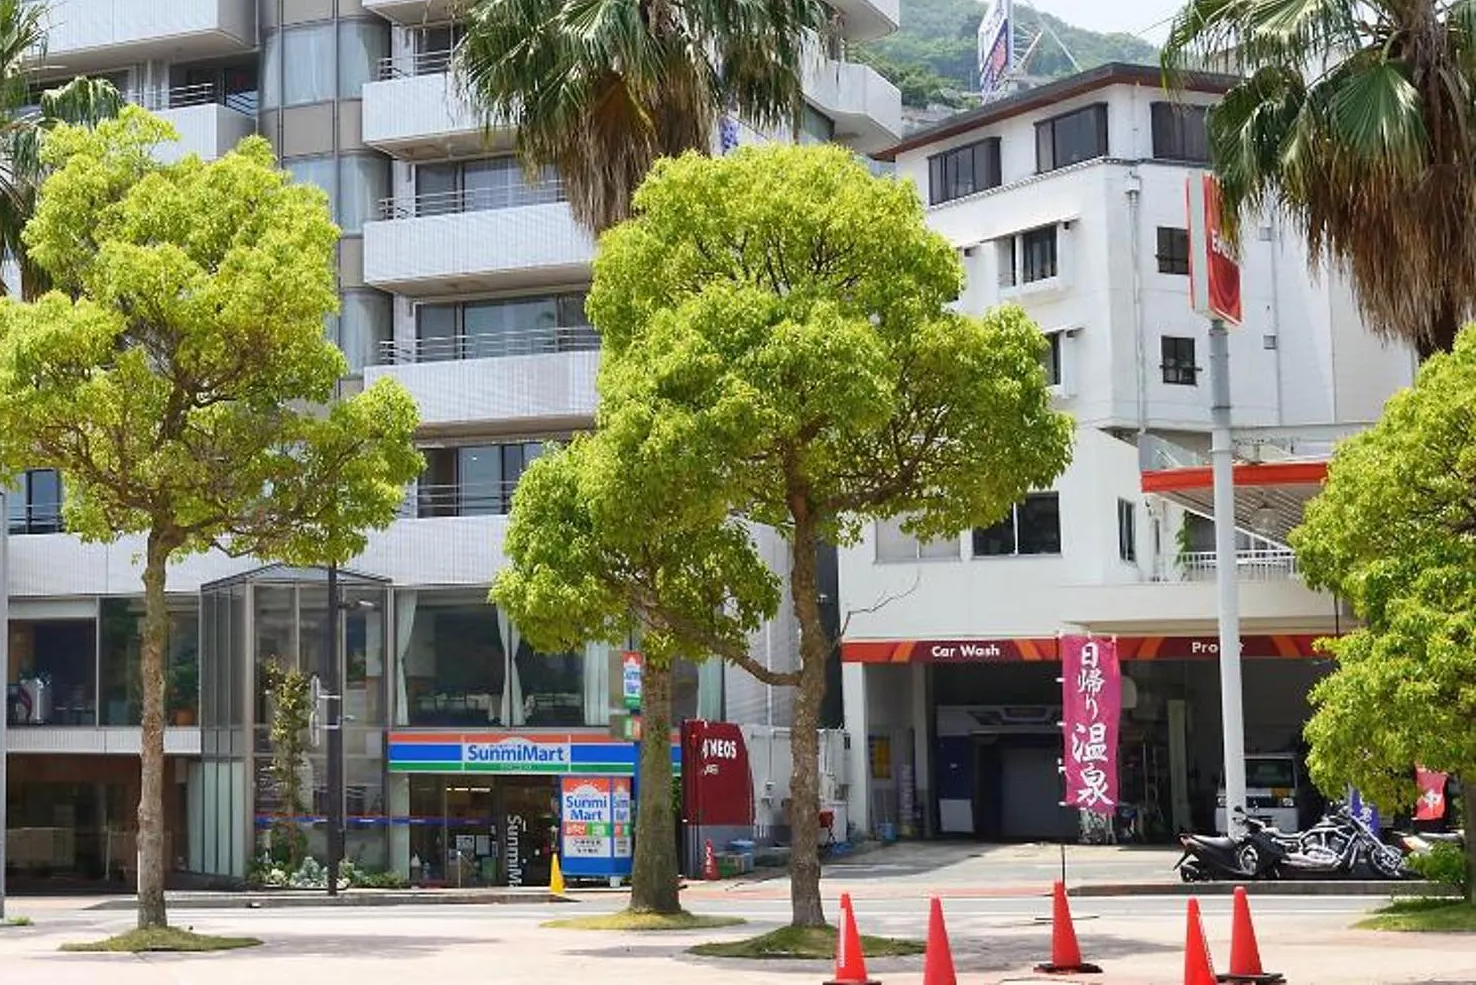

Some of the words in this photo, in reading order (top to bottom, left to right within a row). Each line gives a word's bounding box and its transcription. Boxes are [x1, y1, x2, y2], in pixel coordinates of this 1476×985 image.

[932, 646, 955, 657] Car
[960, 644, 1000, 657] Wash
[1072, 642, 1115, 807] 日帰り温泉
[467, 744, 565, 762] SunmiMart
[566, 795, 607, 808] Sunmi
[570, 809, 603, 821] Mart
